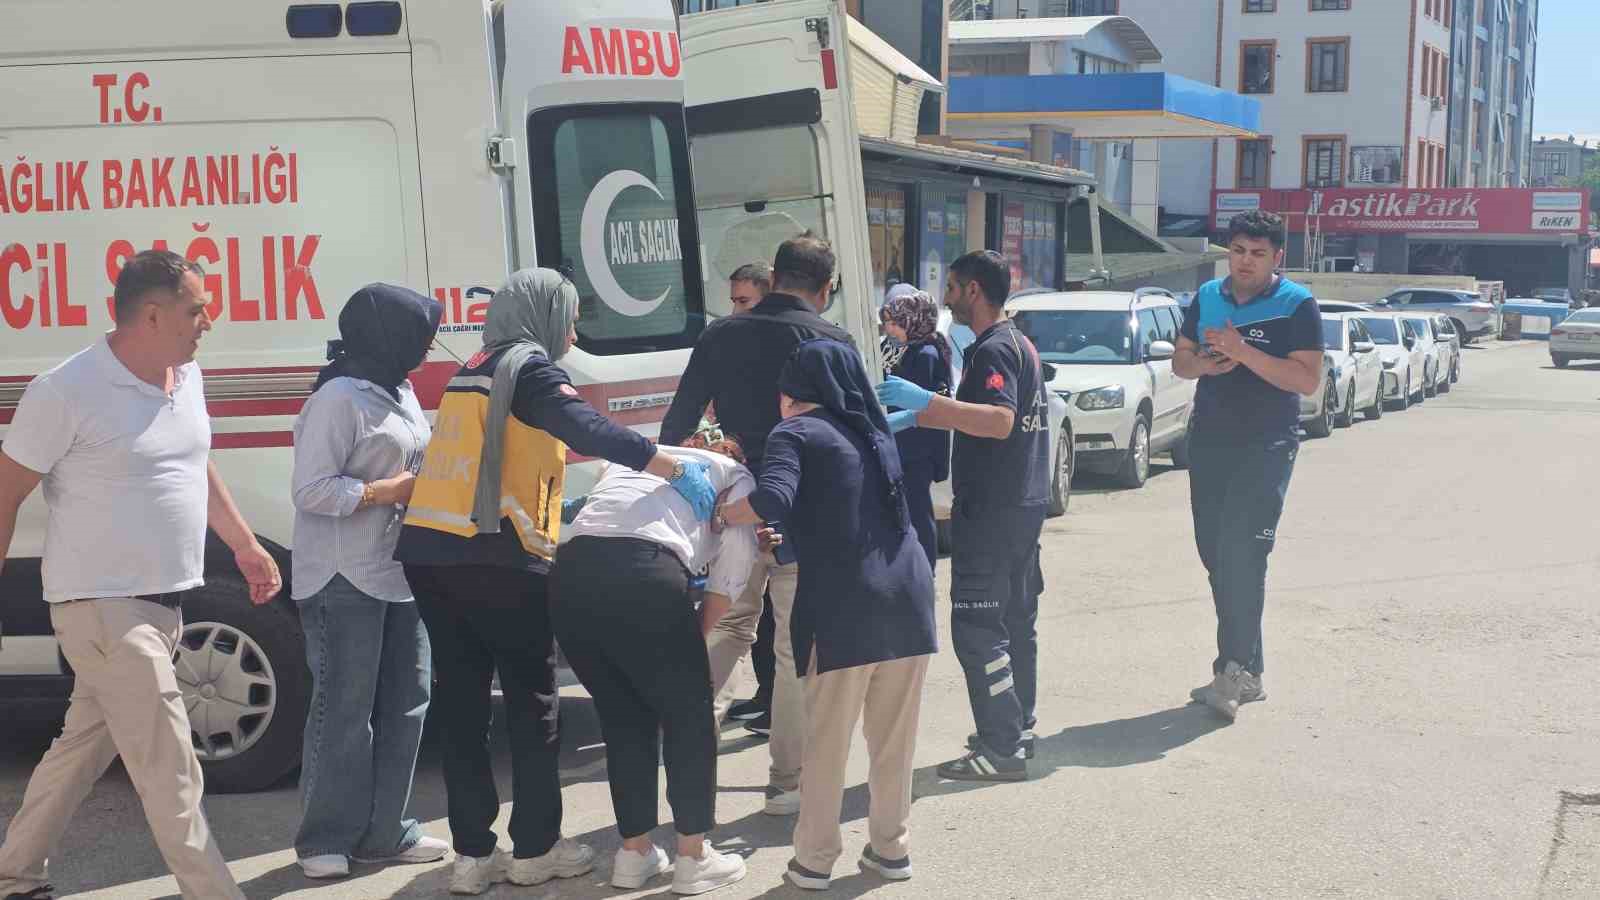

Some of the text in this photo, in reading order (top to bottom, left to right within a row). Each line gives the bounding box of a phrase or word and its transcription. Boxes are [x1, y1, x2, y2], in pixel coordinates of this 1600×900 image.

[561, 25, 681, 78] AMBU
[92, 72, 163, 124] T.C.
[102, 146, 299, 210] BAKANLIĞI
